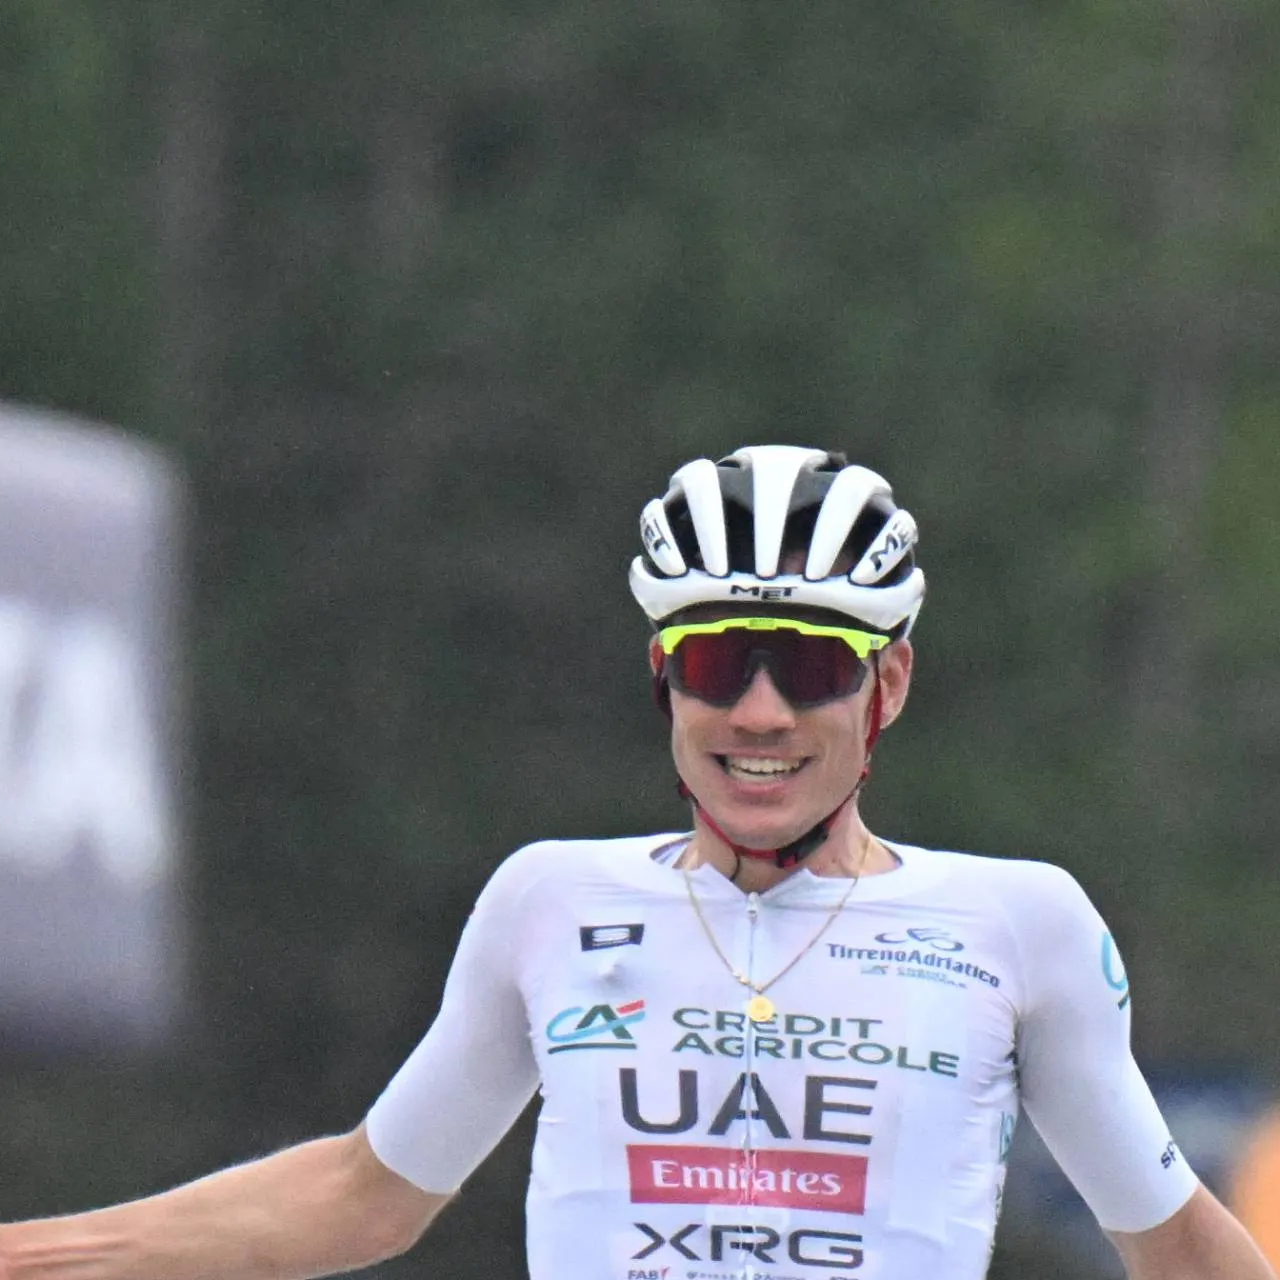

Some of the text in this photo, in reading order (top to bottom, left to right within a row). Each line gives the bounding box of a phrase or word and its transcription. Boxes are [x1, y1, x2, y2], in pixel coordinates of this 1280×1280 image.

[730, 584, 798, 601] MET
[826, 942, 1001, 989] TirrenoAdriatico
[671, 1032, 960, 1078] AGRICOLE
[618, 1067, 878, 1145] UAE
[651, 1159, 844, 1196] Emirates
[630, 1222, 863, 1269] XRG
